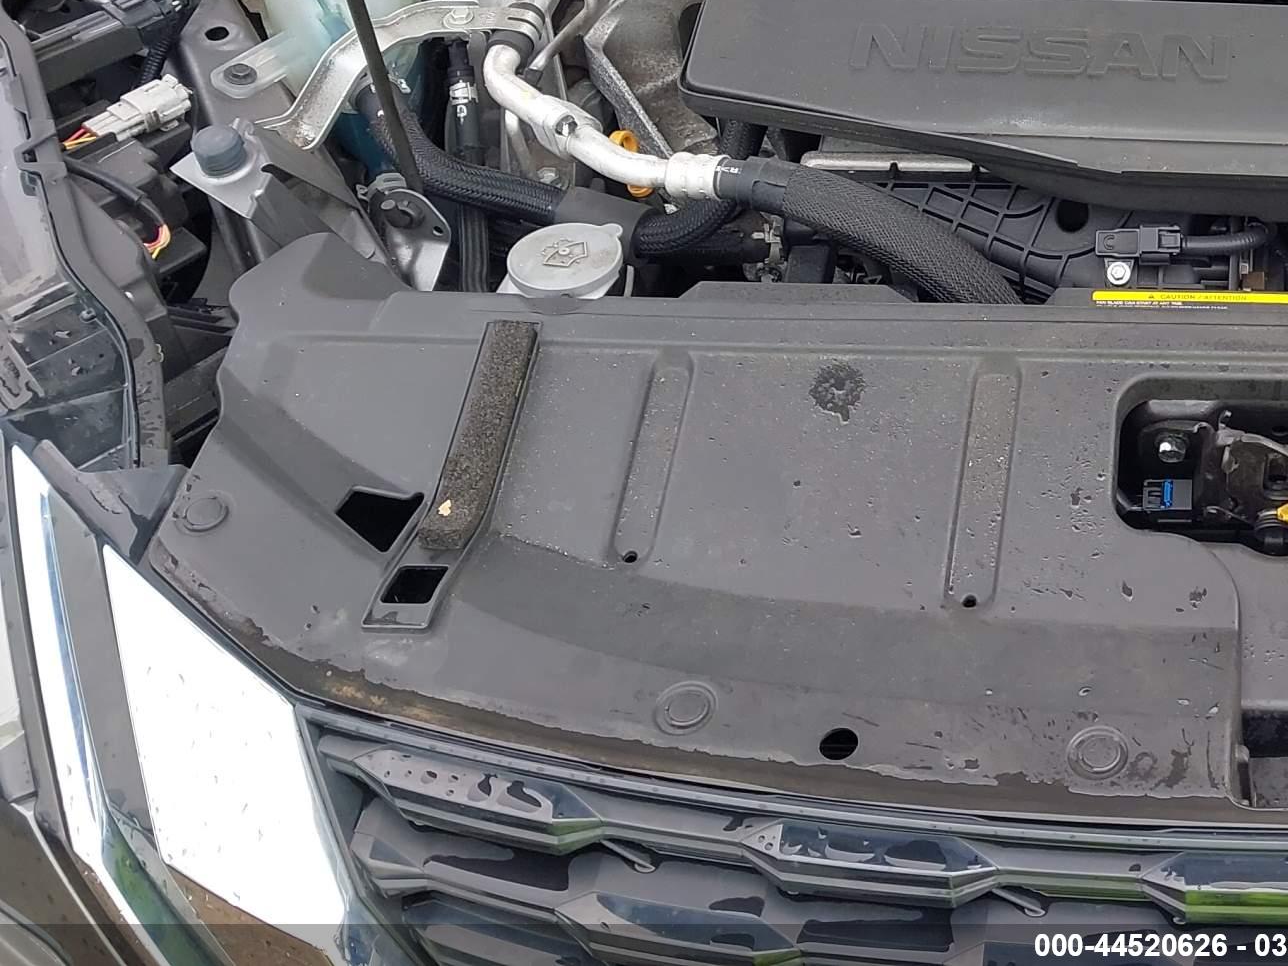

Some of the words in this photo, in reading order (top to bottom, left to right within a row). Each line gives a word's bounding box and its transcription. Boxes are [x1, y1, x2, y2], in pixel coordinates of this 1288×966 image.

[850, 21, 1231, 81] NISSAN
[1160, 293, 1196, 301] CAUTION
[1204, 294, 1247, 302] ATTENTION
